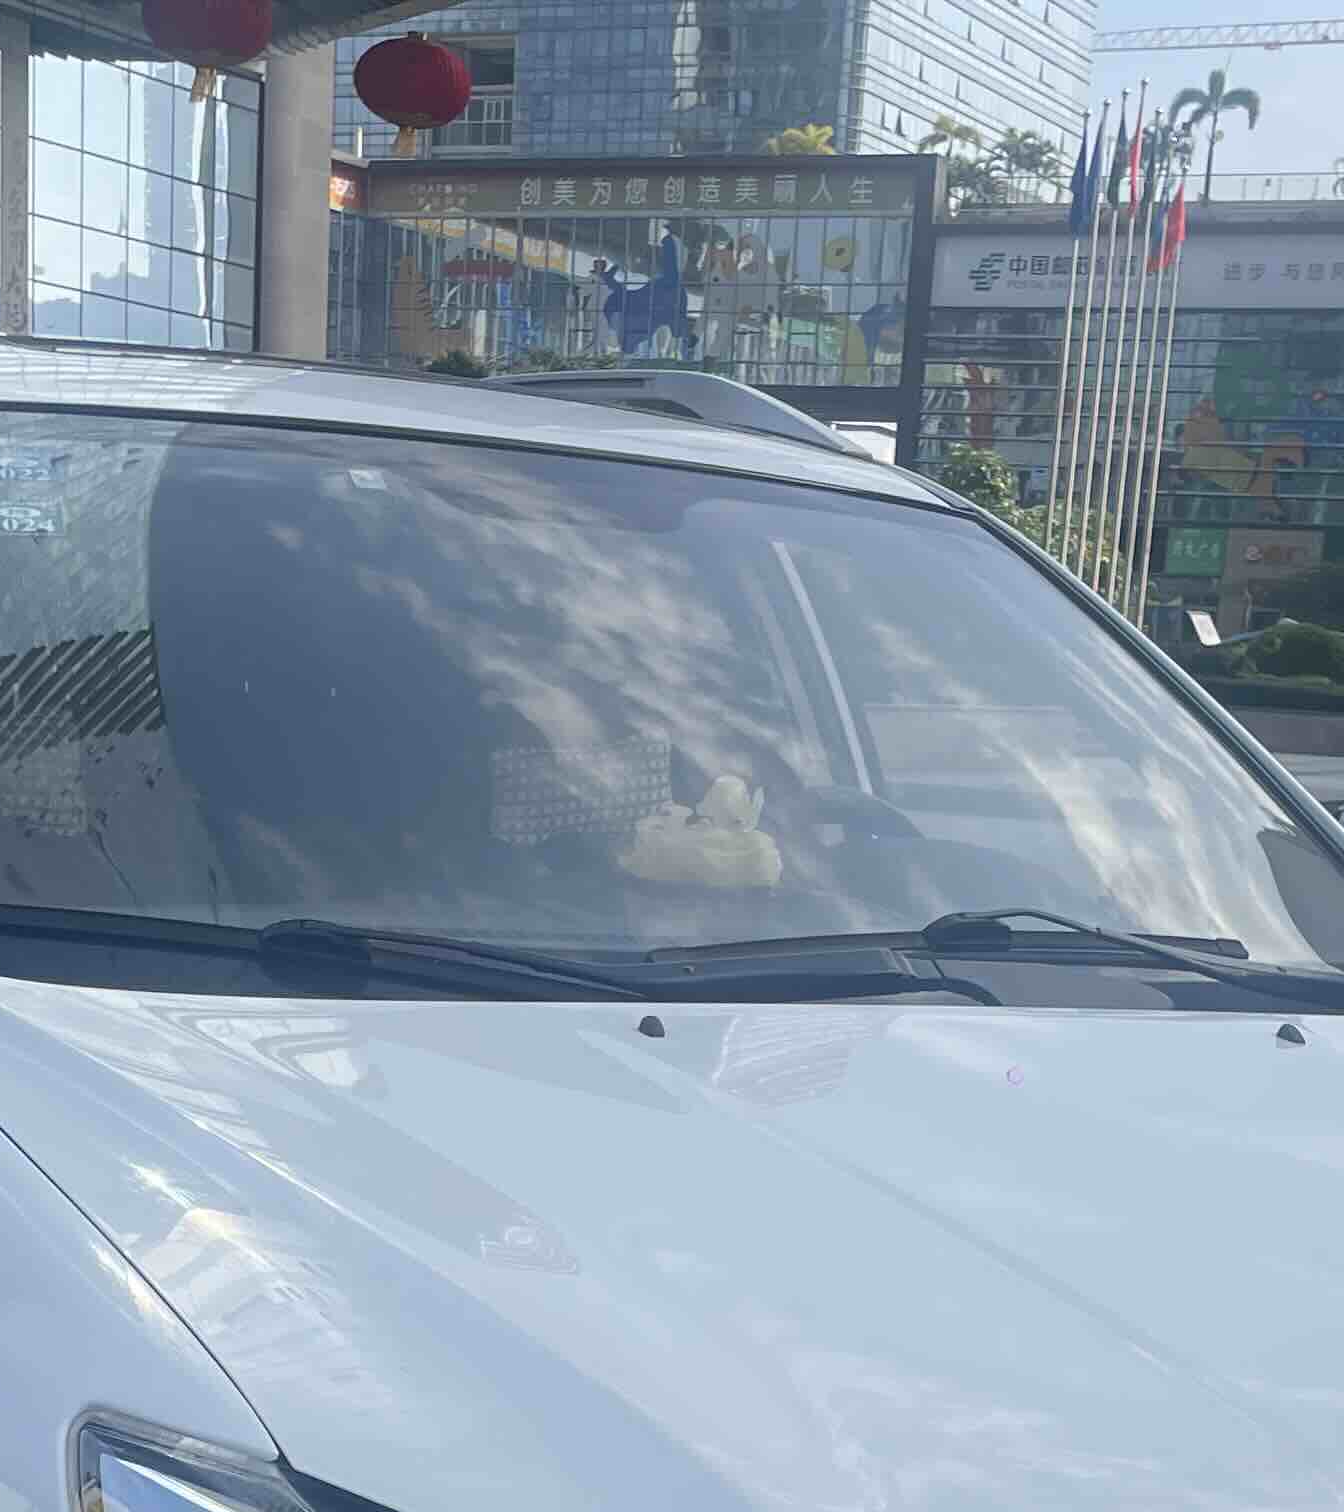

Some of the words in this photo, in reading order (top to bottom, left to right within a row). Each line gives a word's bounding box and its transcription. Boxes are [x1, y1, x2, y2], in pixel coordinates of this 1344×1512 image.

[520, 173, 874, 206] 创美为您创造美丽人生
[1009, 254, 1183, 277] 中国邮政
